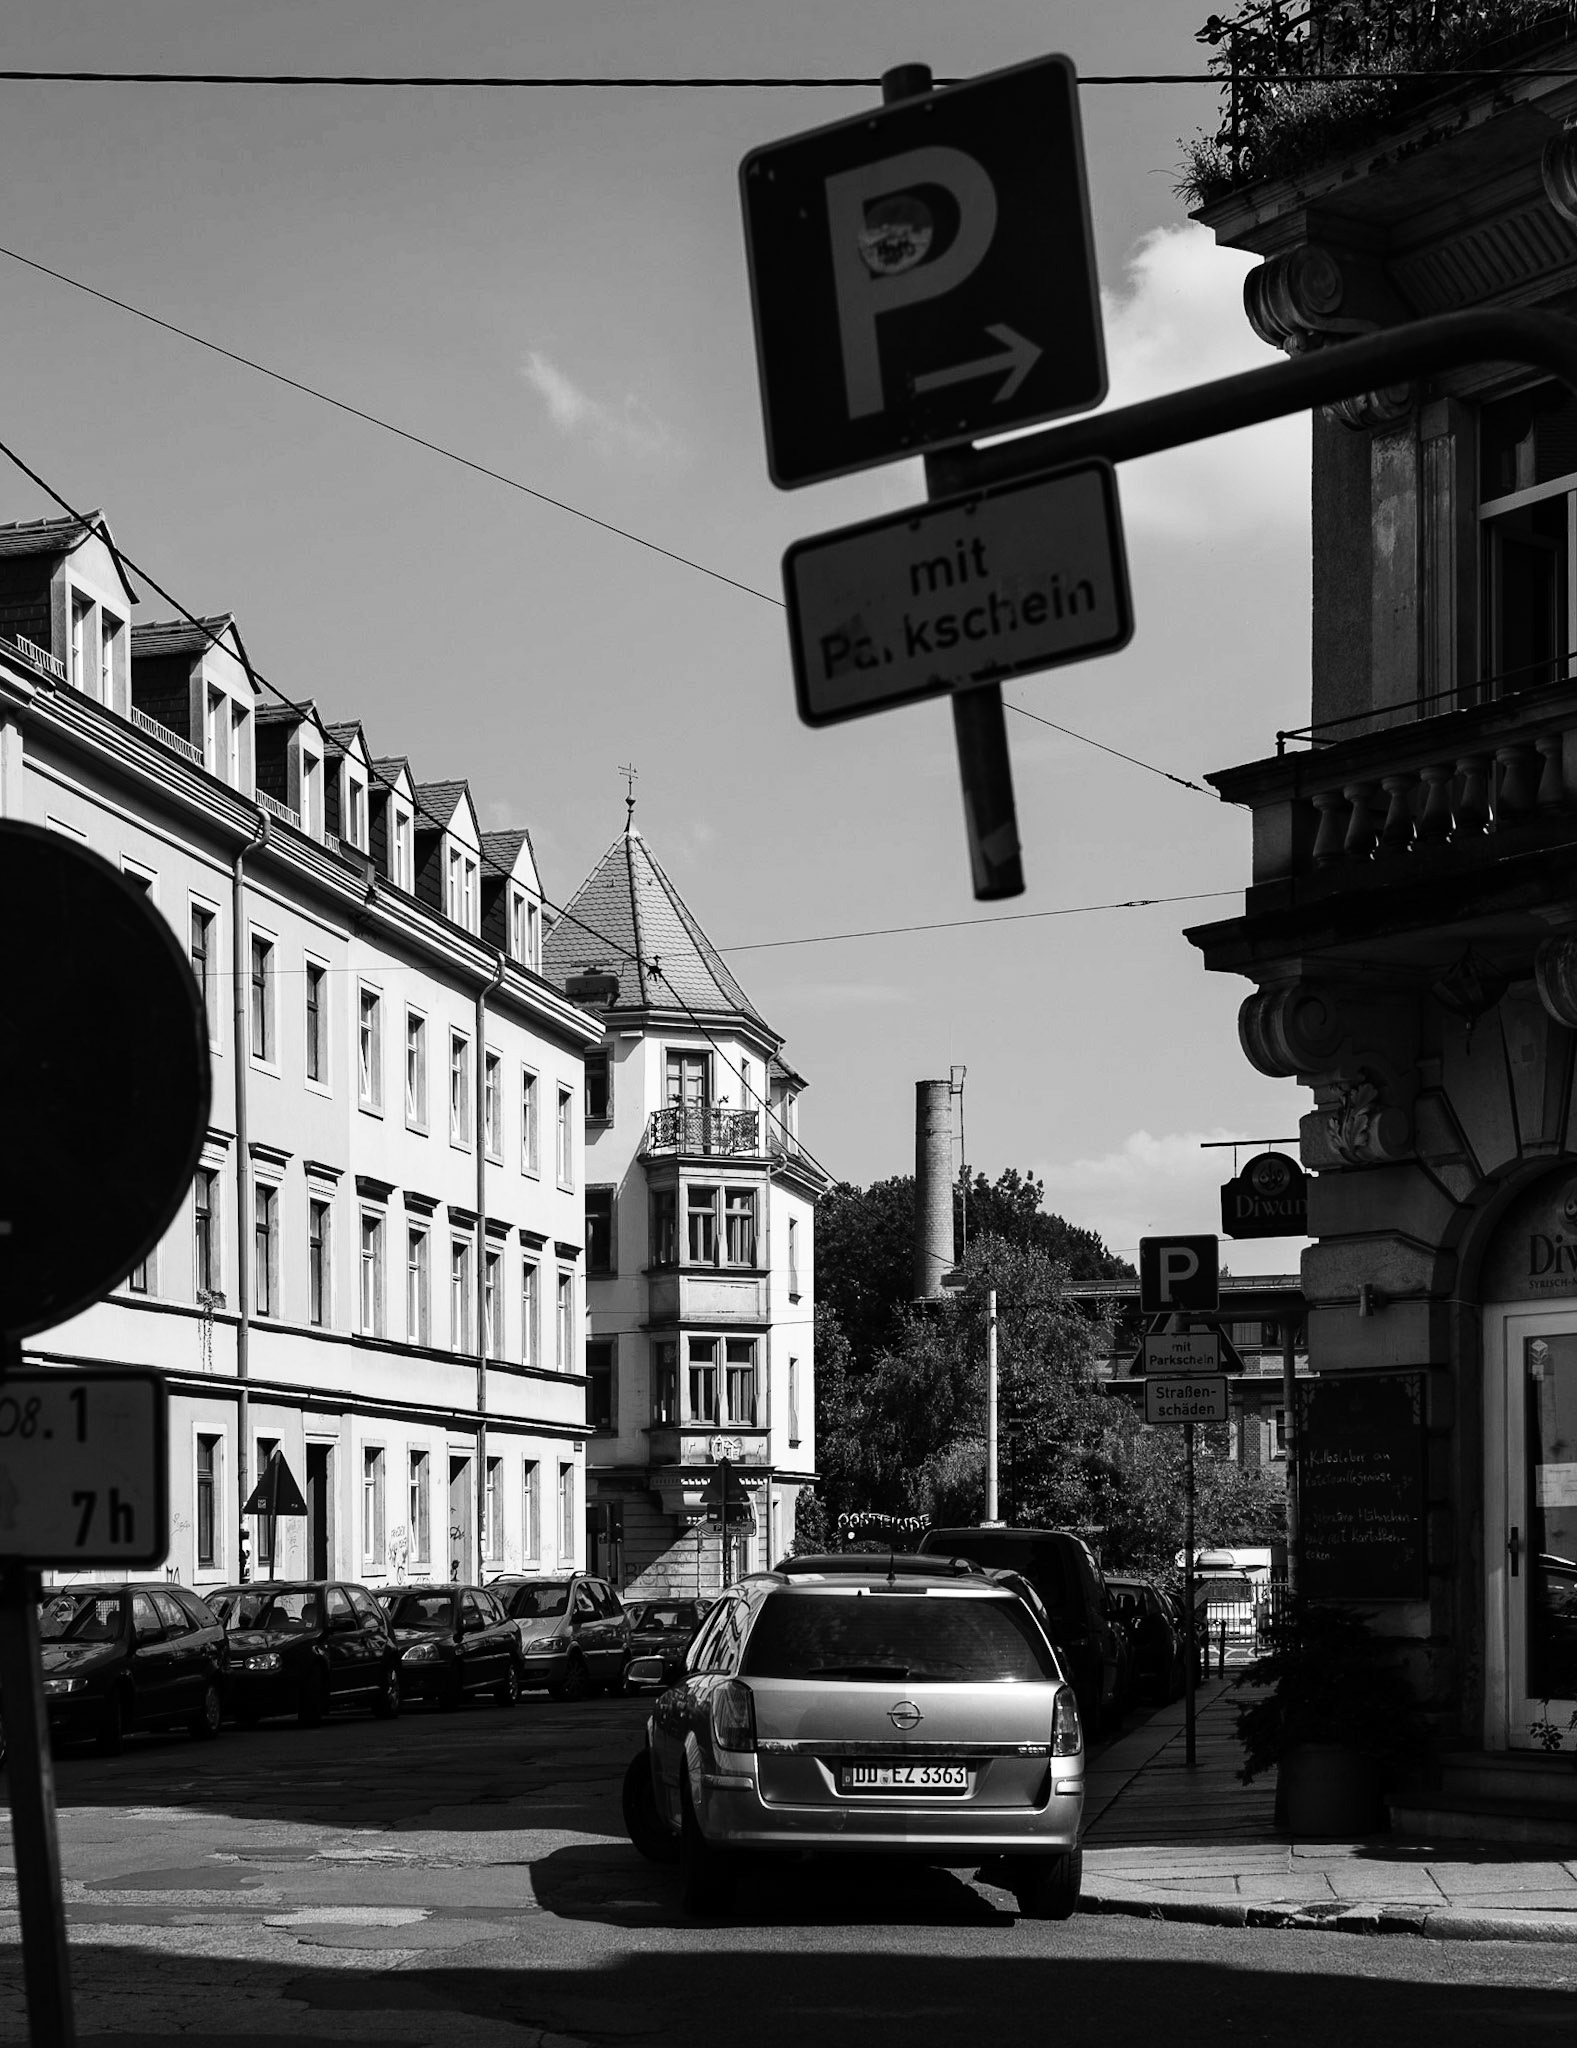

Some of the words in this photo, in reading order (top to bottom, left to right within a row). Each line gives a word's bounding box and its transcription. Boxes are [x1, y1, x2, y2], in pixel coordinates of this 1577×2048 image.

[824, 145, 998, 421] P
[909, 536, 989, 596] mit
[1159, 1246, 1200, 1303] P
[1171, 1342, 1191, 1352] mit
[1150, 1353, 1214, 1366] Parkschein
[1156, 1385, 1217, 1399] Straßen-
[1158, 1402, 1216, 1417] schäden
[855, 1763, 878, 1783] DD
[893, 1763, 915, 1784] EZ
[920, 1763, 964, 1784] 3363
